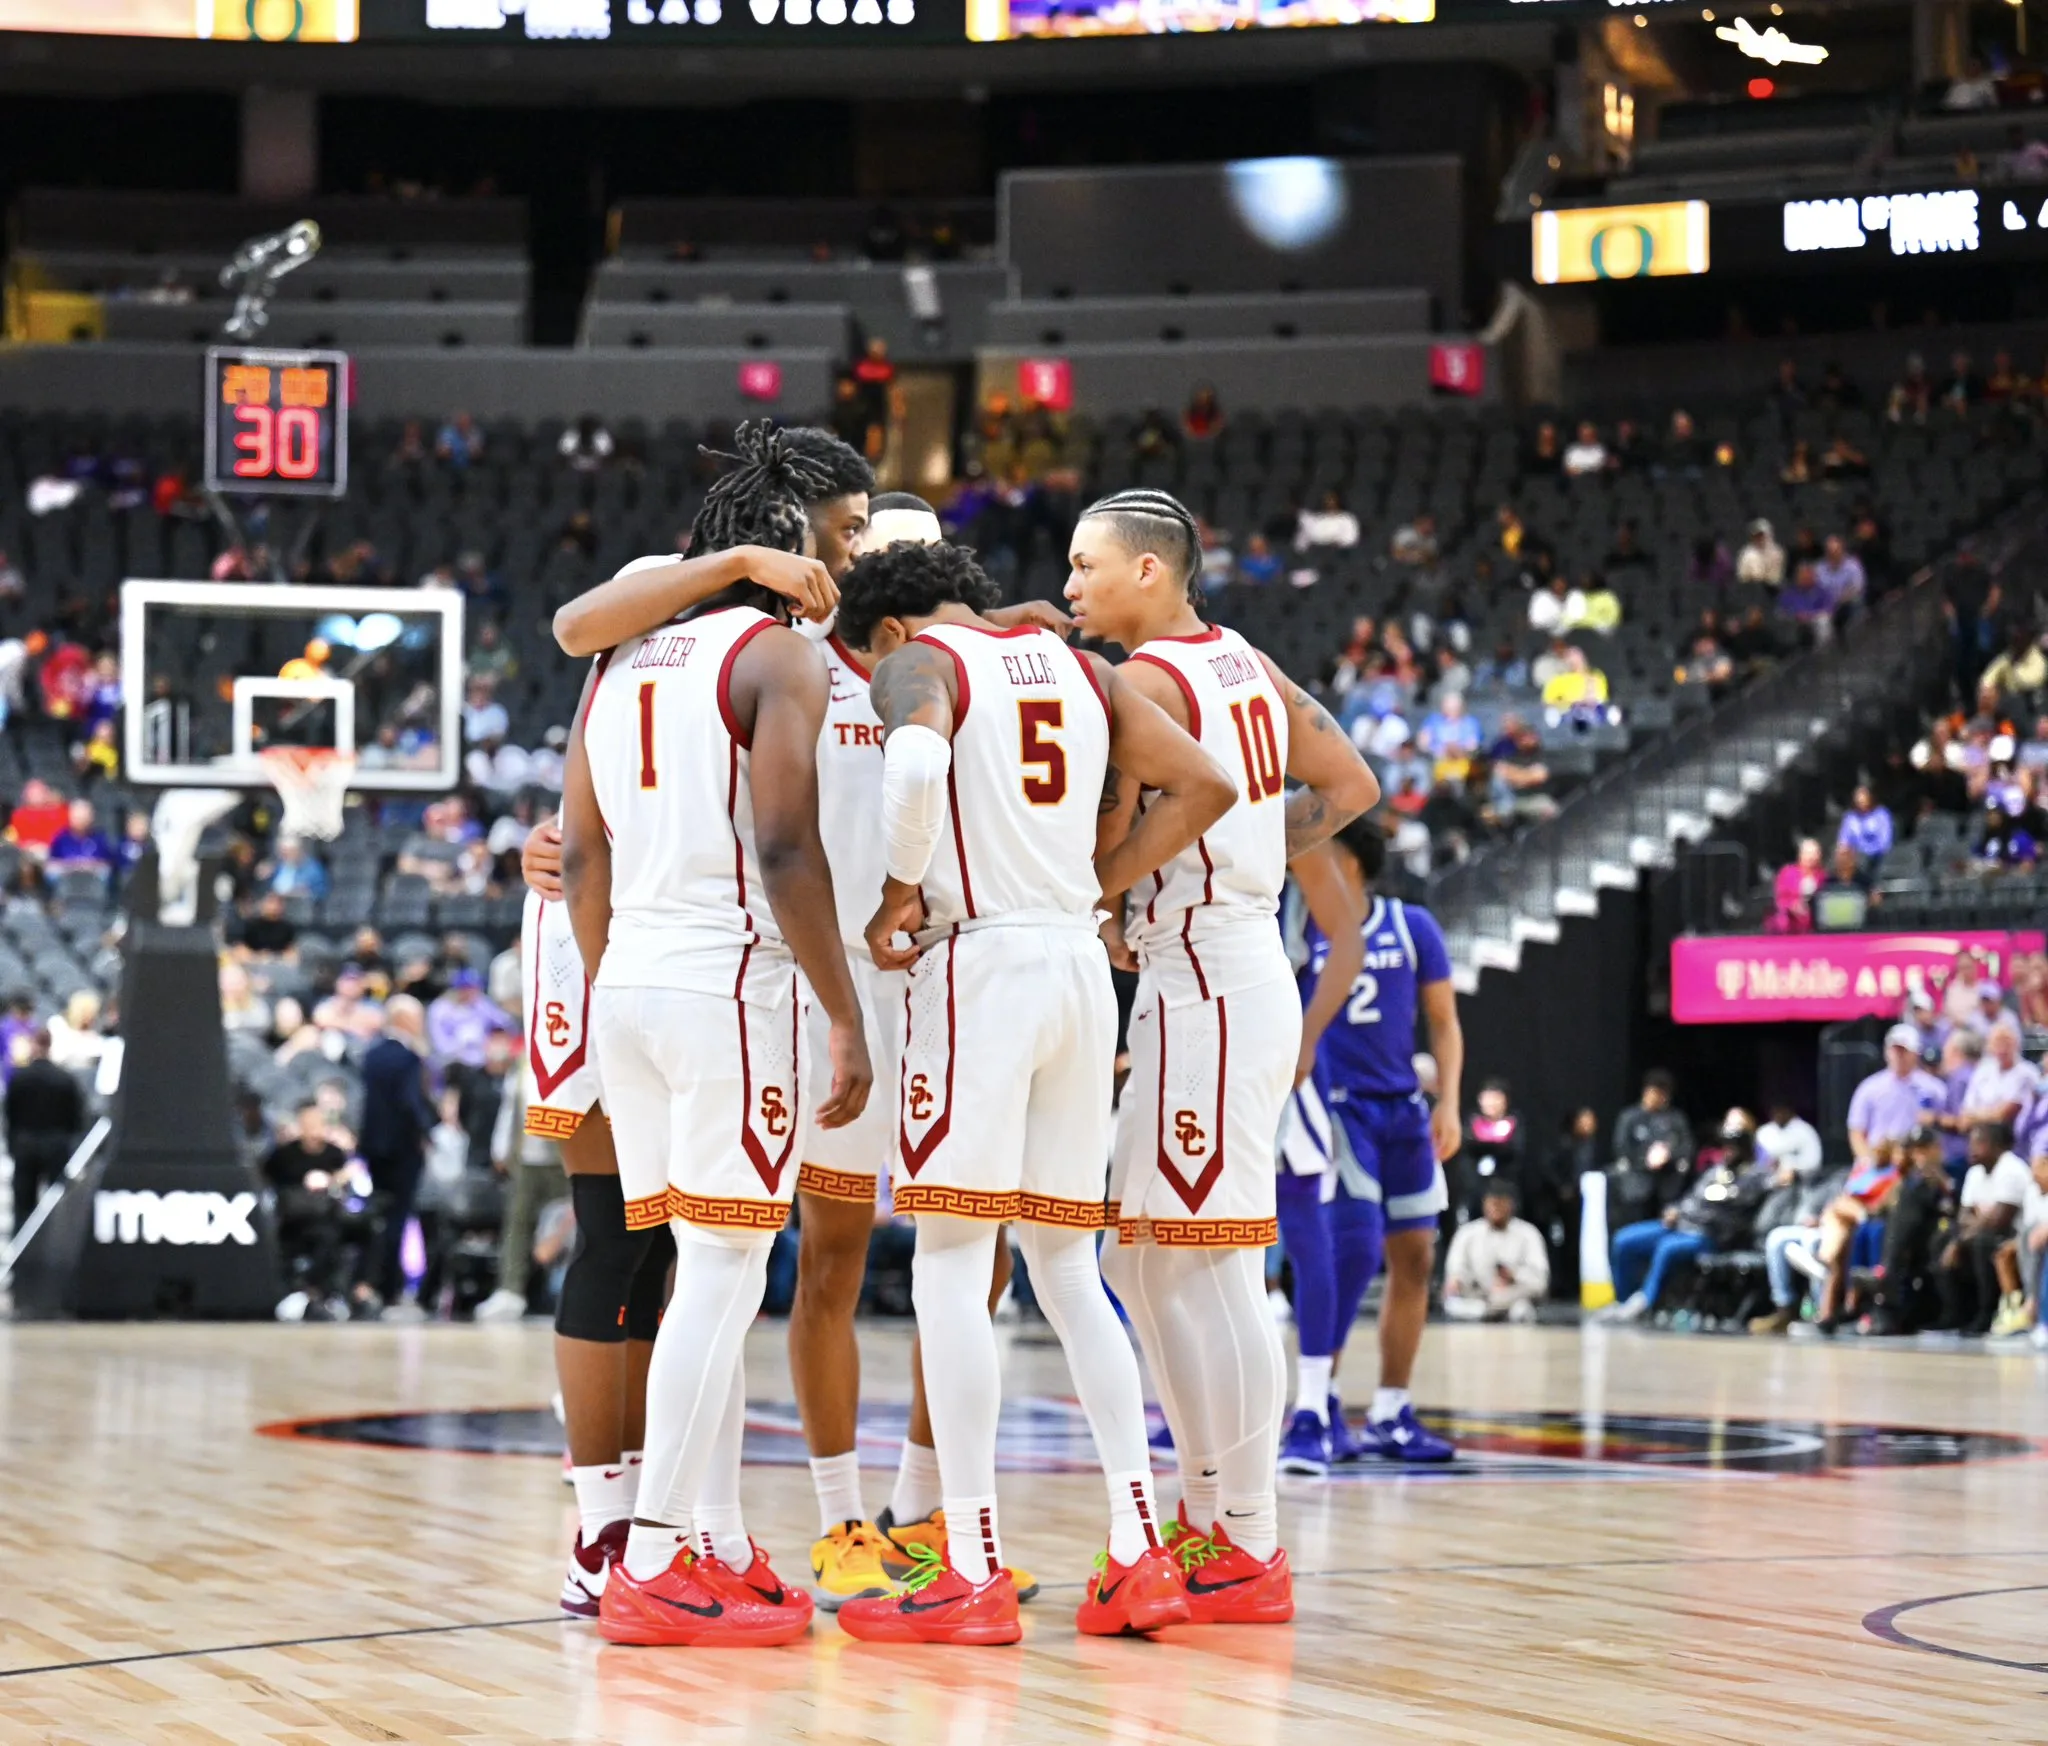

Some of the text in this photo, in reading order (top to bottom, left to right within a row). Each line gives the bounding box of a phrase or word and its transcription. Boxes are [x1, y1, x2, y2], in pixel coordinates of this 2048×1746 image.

[627, 0, 722, 25] LAS
[749, 0, 916, 25] VEGAS
[1591, 223, 1654, 279] O
[233, 405, 320, 479] 30
[631, 636, 697, 669] COLLIER
[1001, 652, 1057, 686] ELLIS
[639, 680, 658, 790] 1
[833, 722, 885, 747] TRO
[1016, 698, 1068, 807] 5
[1229, 693, 1284, 805] 10
[1347, 972, 1381, 1025] 2
[93, 1189, 259, 1246] max
